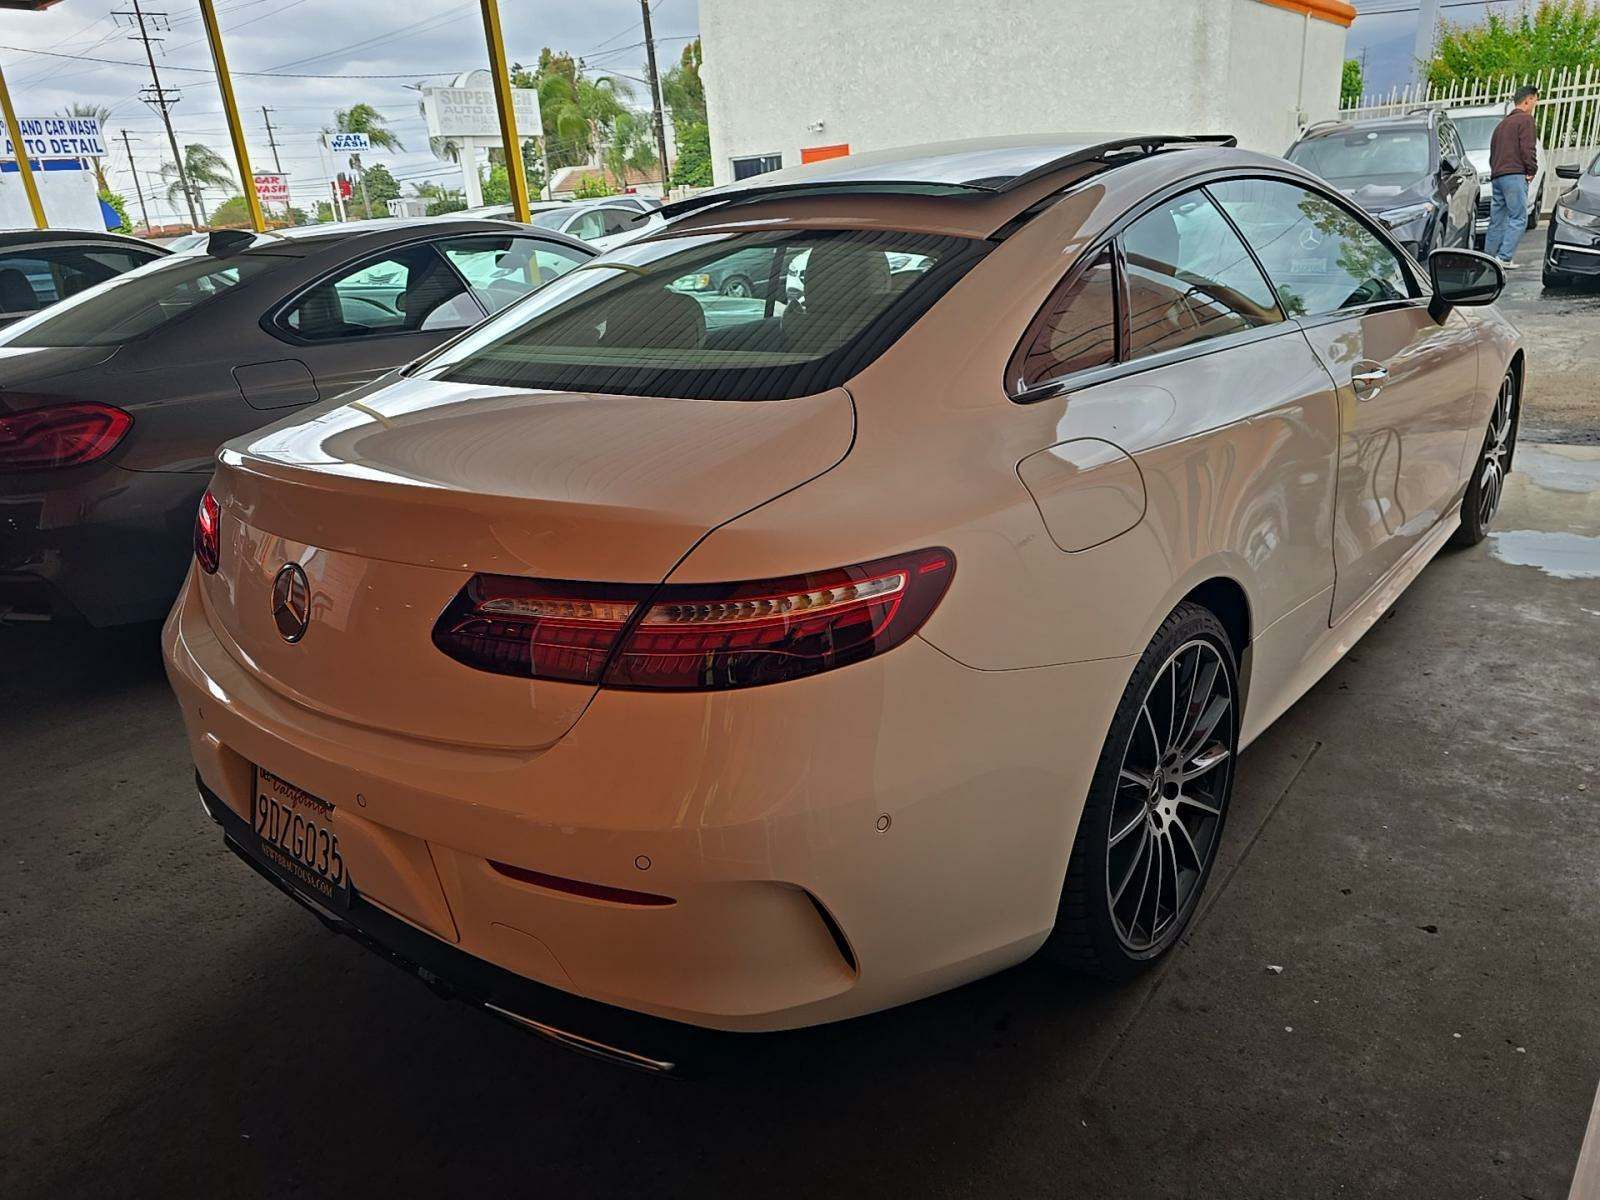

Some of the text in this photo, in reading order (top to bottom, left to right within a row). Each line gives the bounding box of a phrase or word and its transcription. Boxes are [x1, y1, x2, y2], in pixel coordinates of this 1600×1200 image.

[45, 120, 68, 135] CAR
[67, 120, 99, 135] WASH
[6, 138, 104, 154] ATO DETAIL
[255, 176, 280, 184] CAR
[258, 792, 343, 884] 9DZG035
